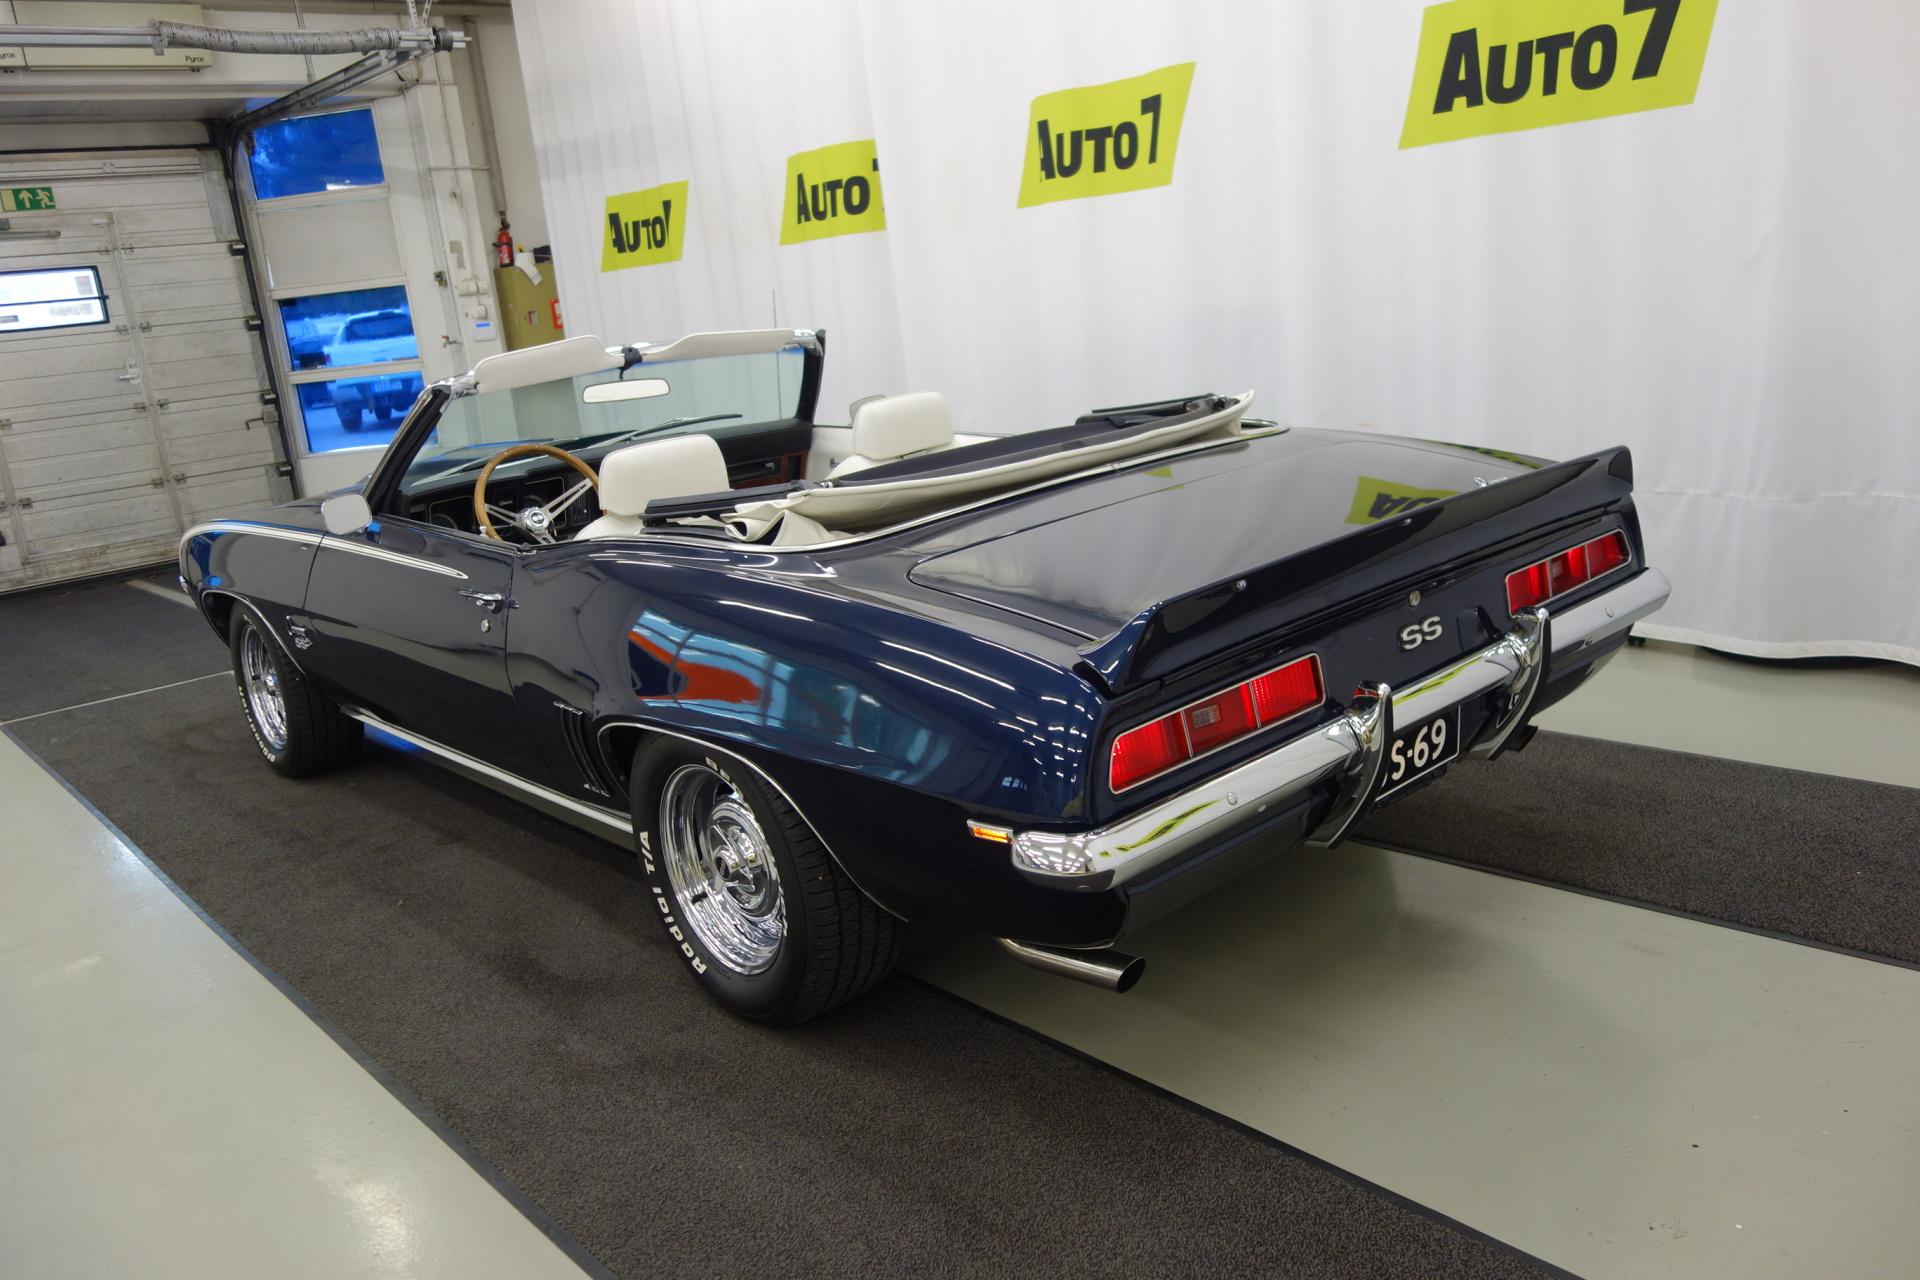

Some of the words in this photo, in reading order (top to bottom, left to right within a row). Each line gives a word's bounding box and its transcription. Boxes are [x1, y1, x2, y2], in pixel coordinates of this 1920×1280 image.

[1401, 616, 1443, 650] SS
[1381, 718, 1447, 788] S-69
[639, 831, 656, 875] T/A
[652, 886, 708, 975] Radial
